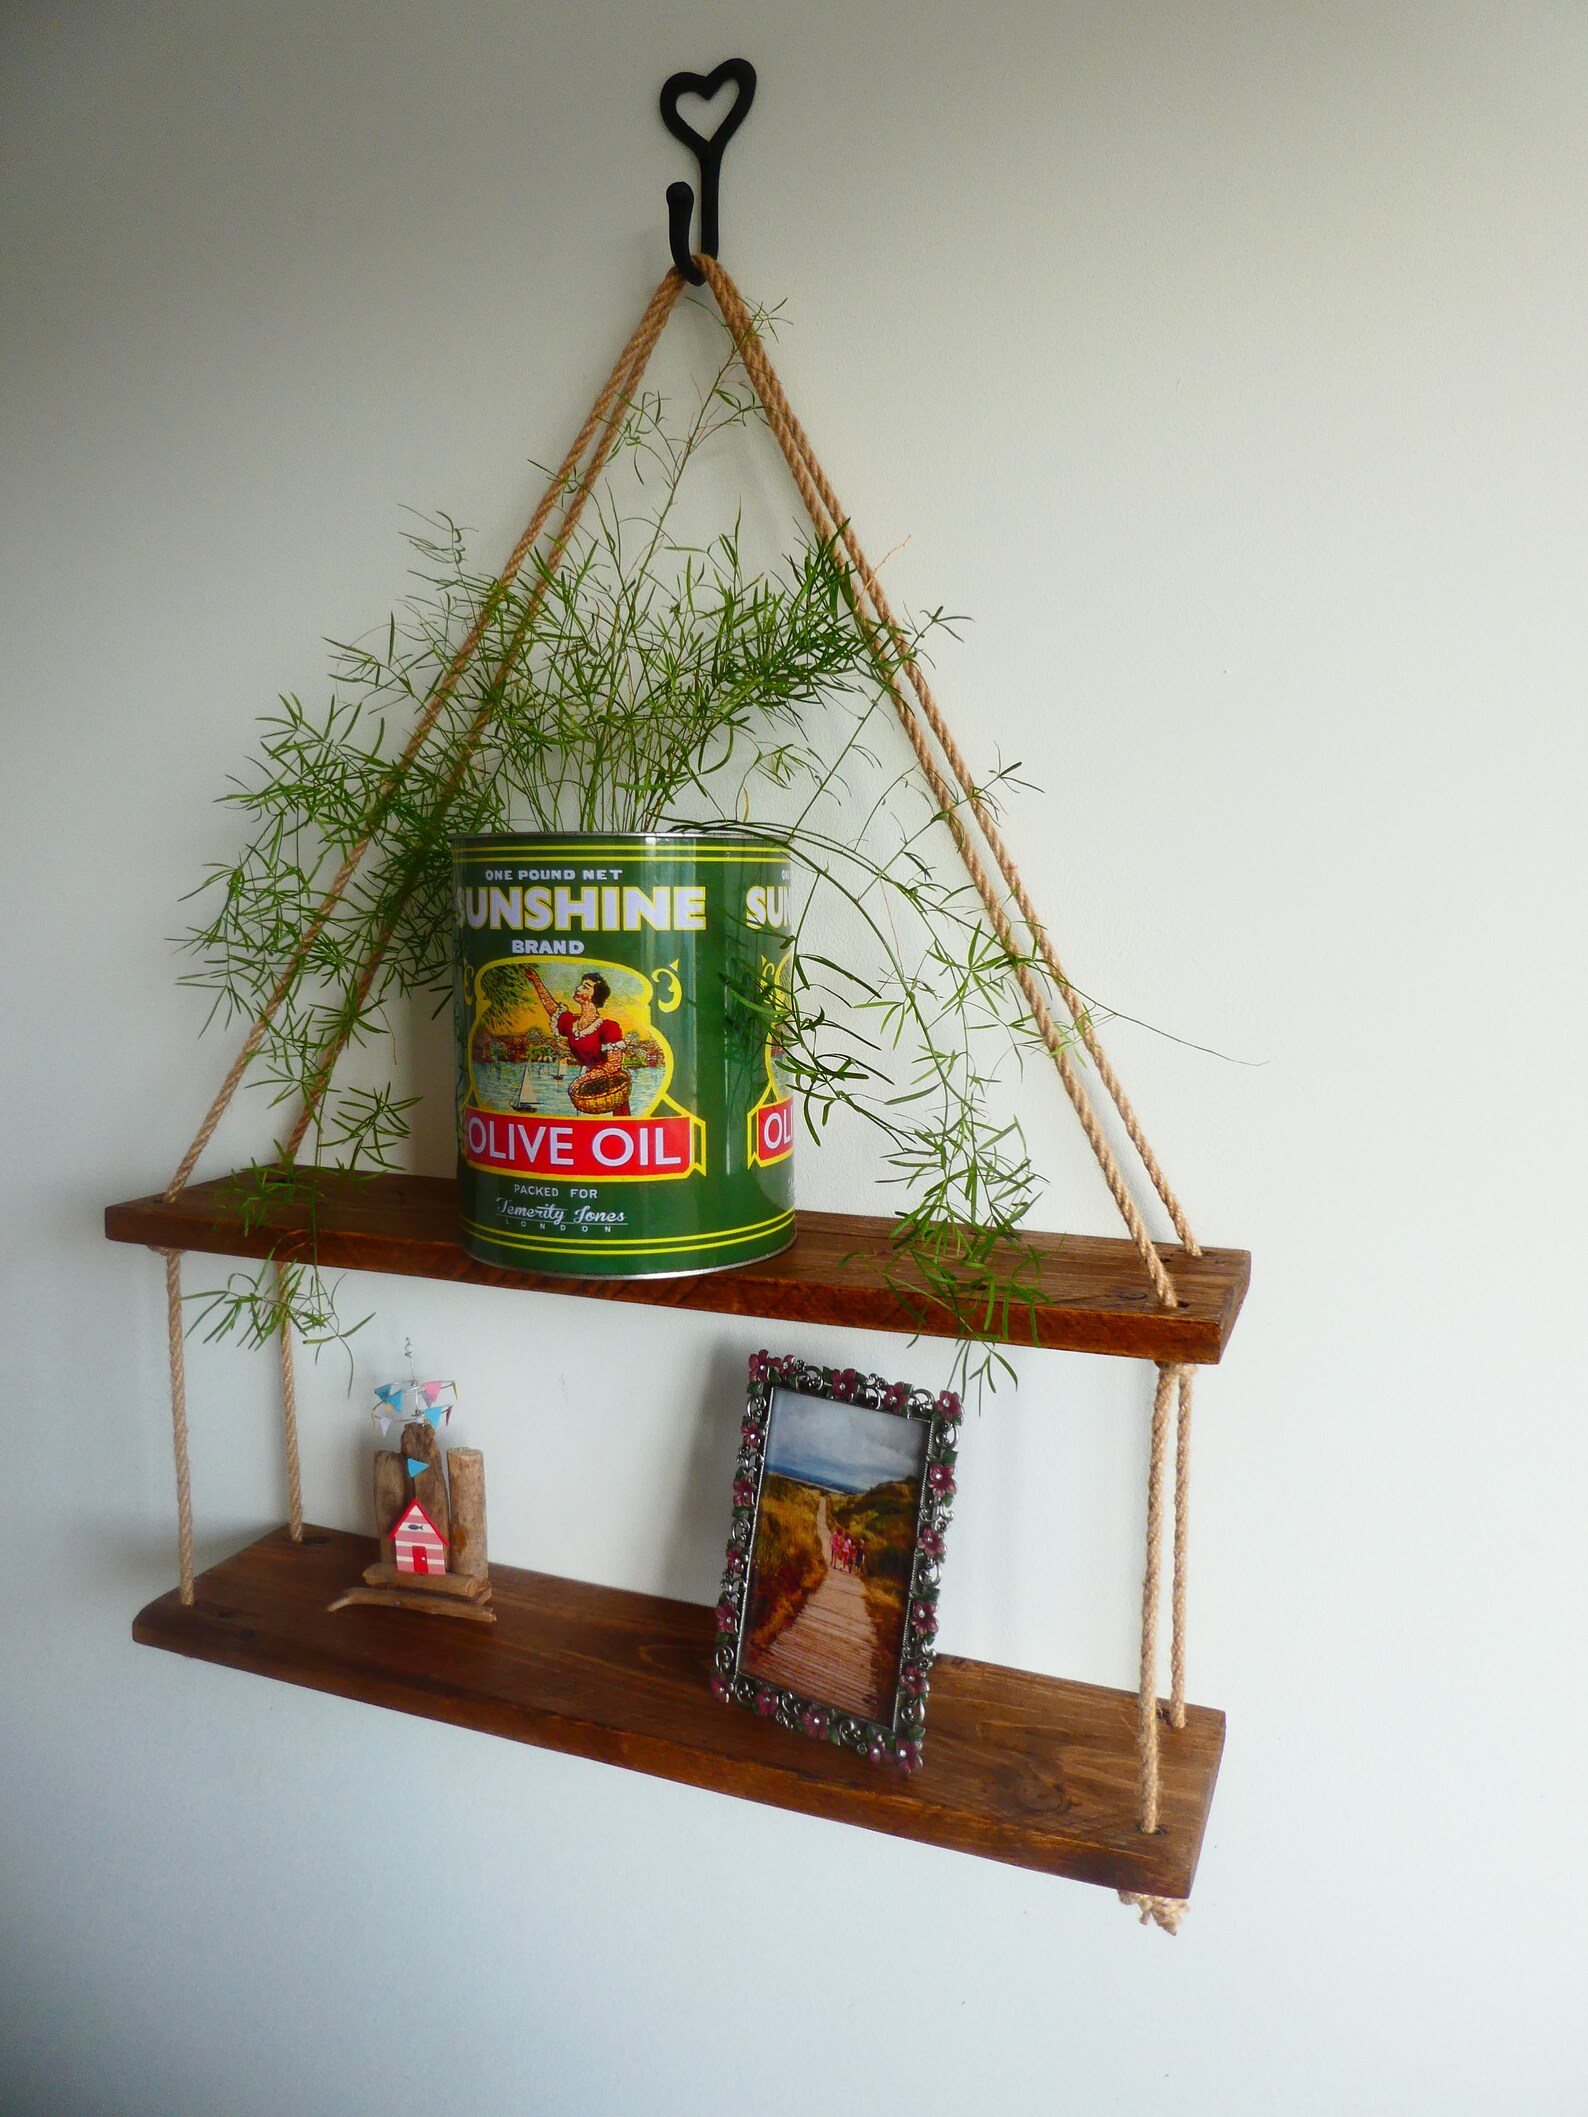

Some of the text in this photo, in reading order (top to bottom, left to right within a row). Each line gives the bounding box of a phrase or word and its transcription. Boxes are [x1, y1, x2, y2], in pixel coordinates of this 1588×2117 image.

[485, 869, 623, 881] ONE POUND NET
[511, 939, 585, 955] BRAND
[468, 1116, 681, 1167] OLIVE OIL
[514, 1183, 598, 1199] PACKED FOR
[496, 1197, 626, 1226] Temerity Jones
